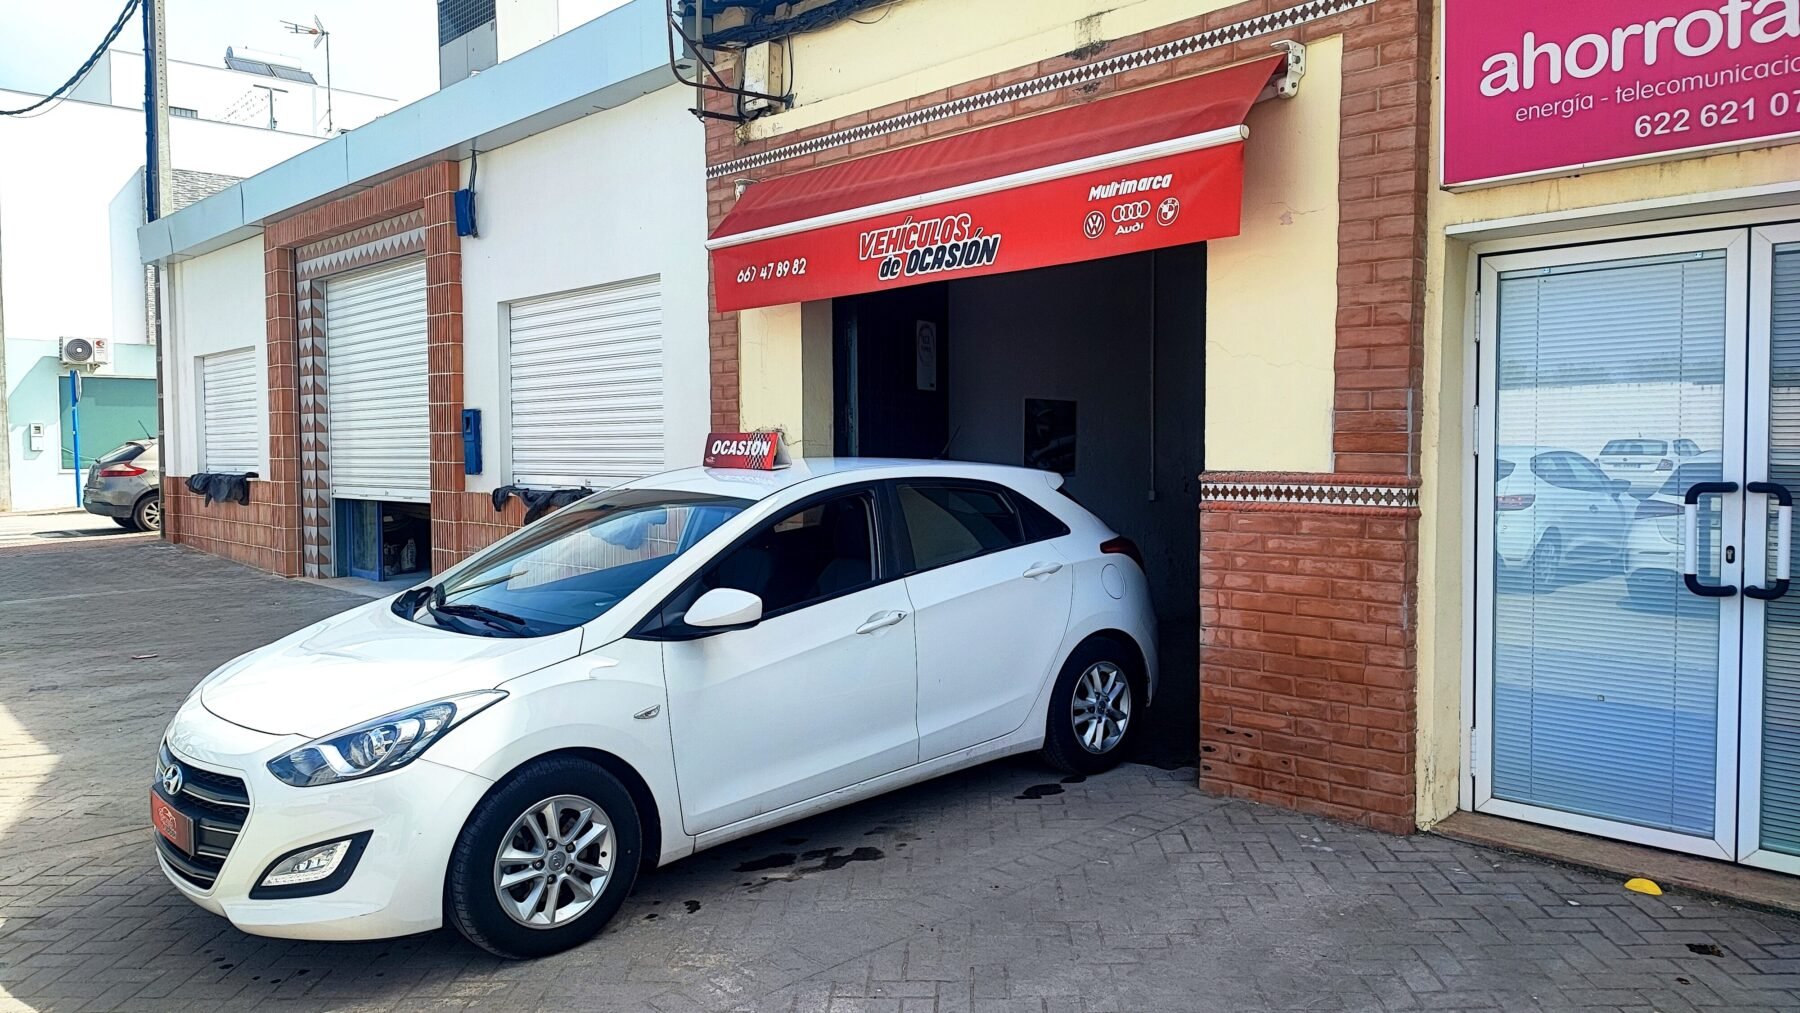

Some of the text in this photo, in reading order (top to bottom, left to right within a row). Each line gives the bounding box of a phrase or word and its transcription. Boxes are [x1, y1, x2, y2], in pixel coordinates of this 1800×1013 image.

[1515, 93, 1594, 121] energía
[1634, 108, 1690, 138] 622
[1700, 97, 1755, 128] 621
[1088, 174, 1173, 201] Multimarca
[860, 213, 971, 260] VEHÍCULOS
[1115, 222, 1144, 235] Audi
[879, 227, 1001, 280] de OCASIÓN
[760, 262, 774, 280] 47
[776, 260, 790, 277] 89
[792, 257, 807, 275] 82
